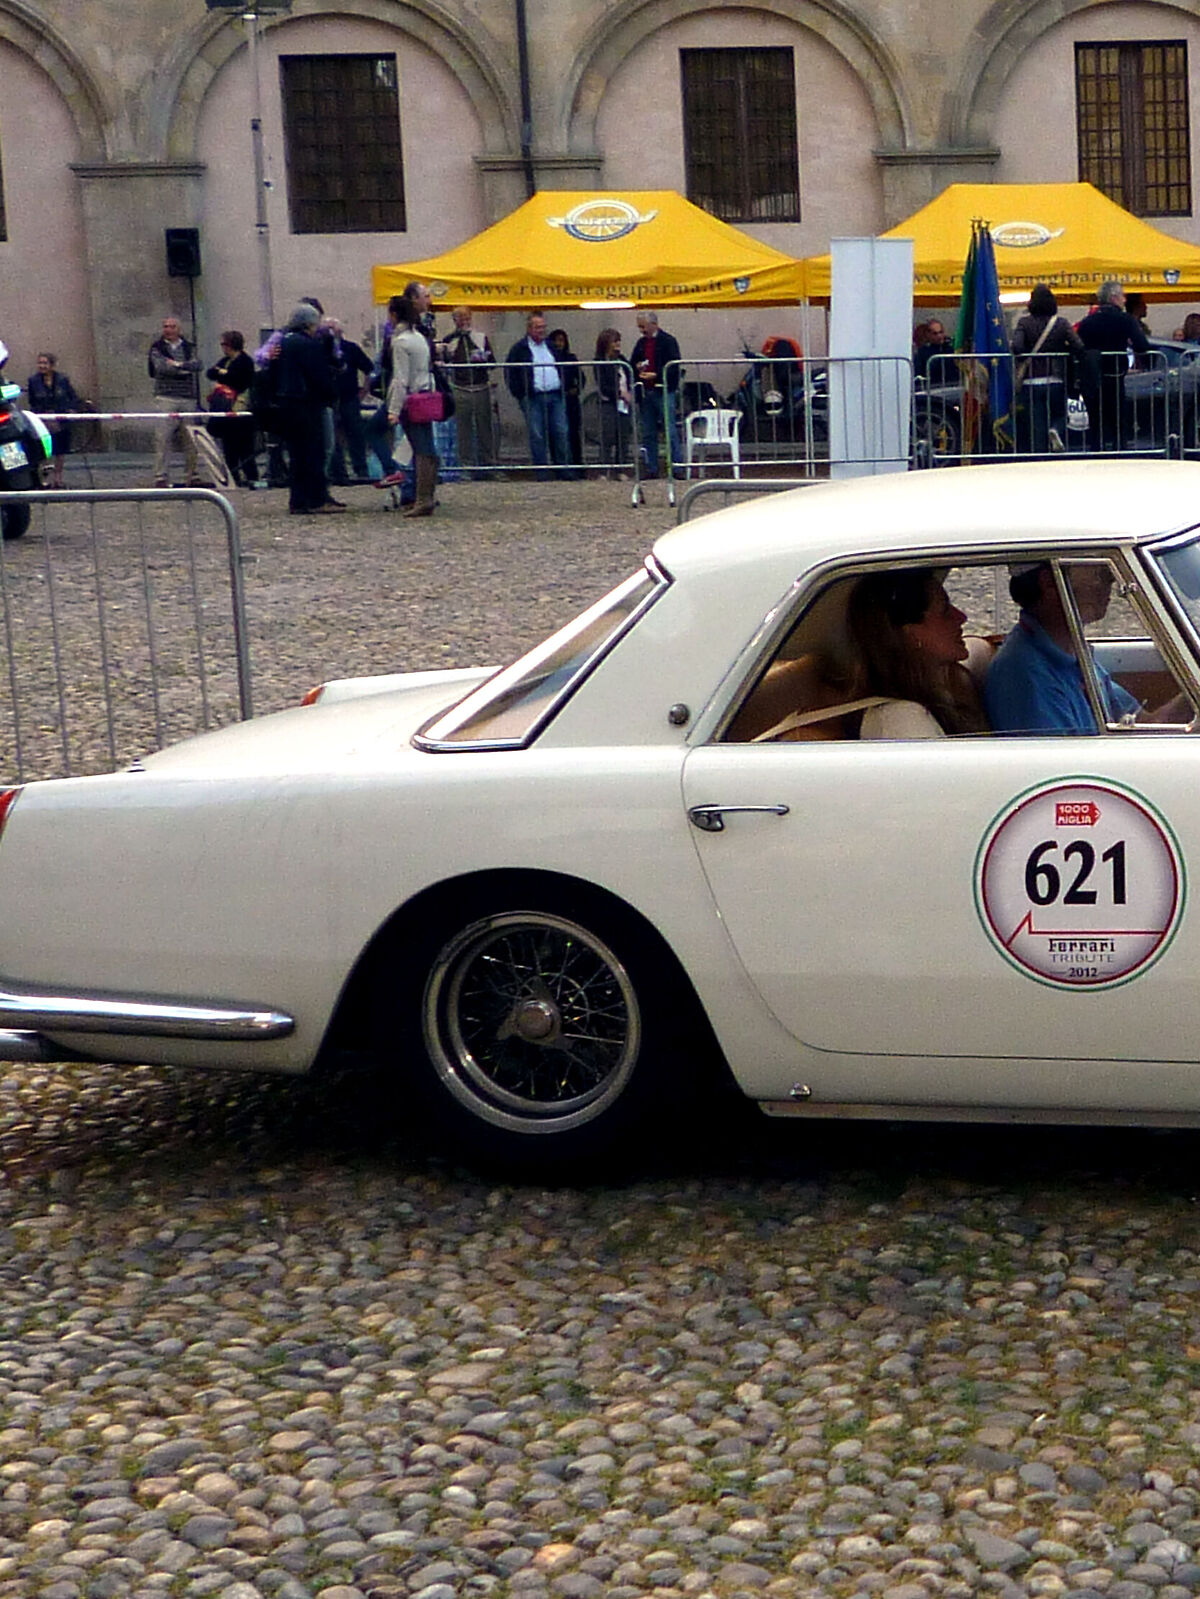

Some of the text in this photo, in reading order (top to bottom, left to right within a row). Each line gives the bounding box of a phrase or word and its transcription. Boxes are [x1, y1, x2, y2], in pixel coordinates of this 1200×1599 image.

[461, 279, 722, 299] www.ruotearaggiparma.it
[1059, 805, 1090, 814] 1000
[1058, 816, 1092, 824] MIGLIA
[1025, 840, 1126, 906] 621
[1049, 938, 1115, 952] Ferrari
[1049, 953, 1115, 963] TRIBUTE
[1069, 967, 1098, 978] 2012
